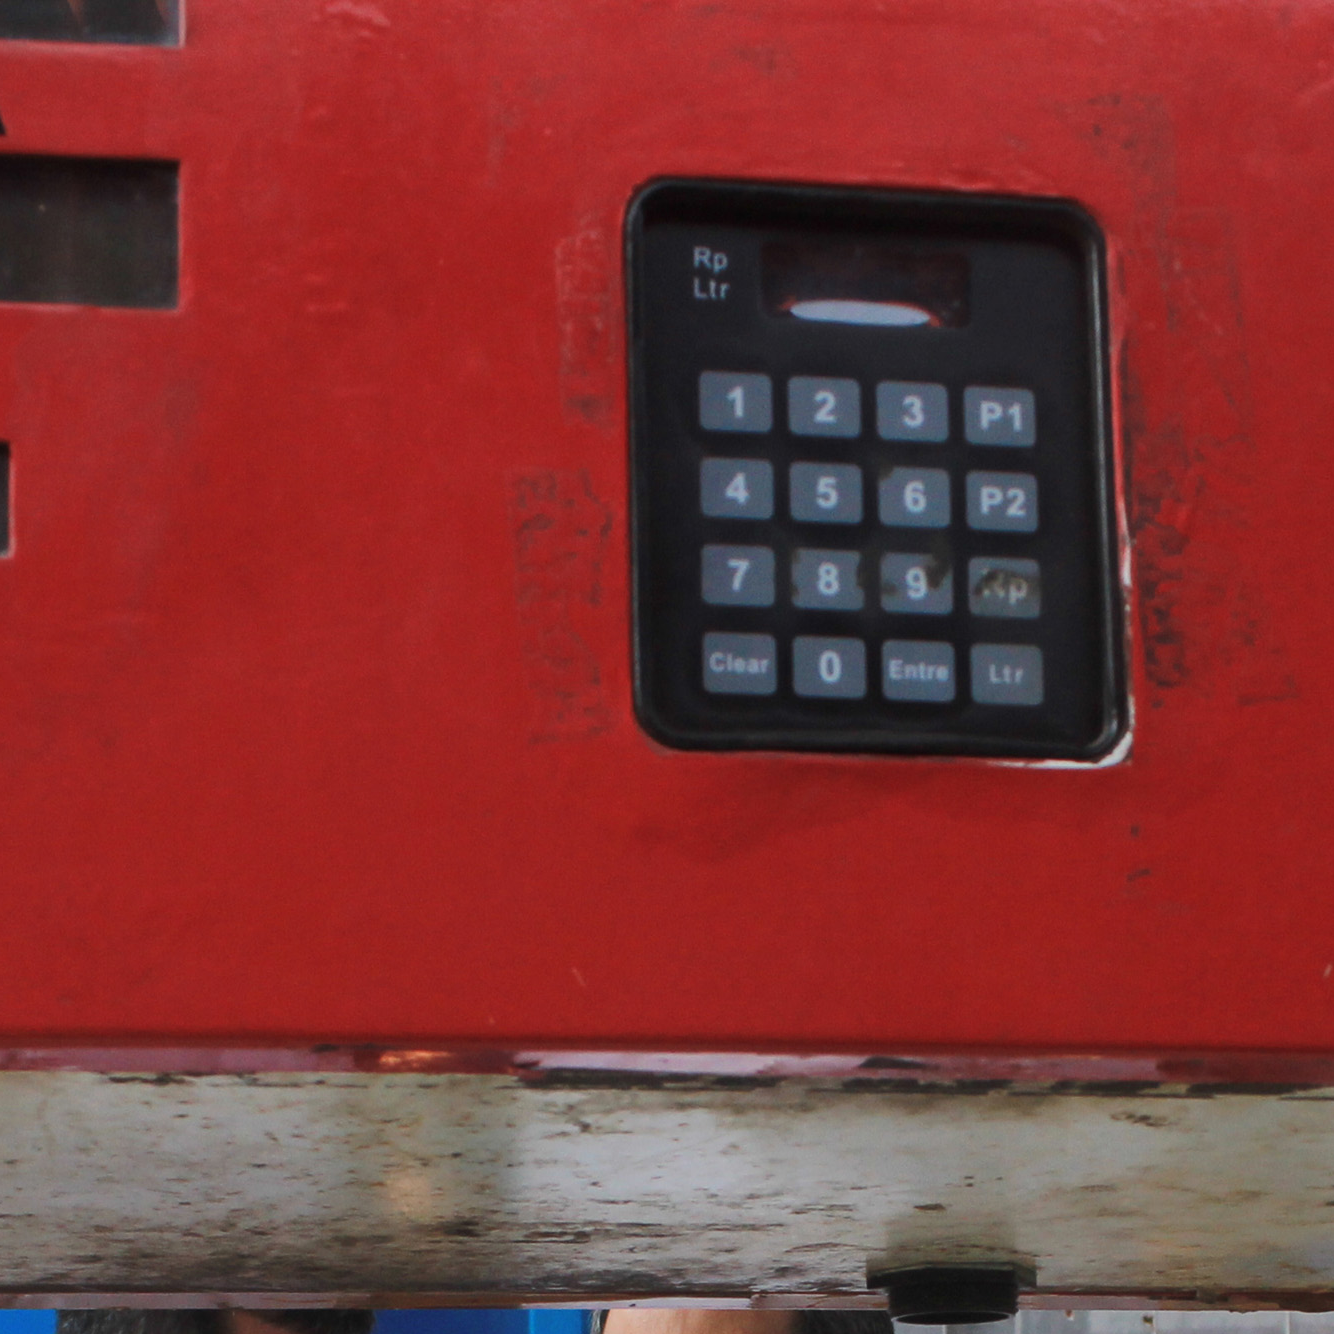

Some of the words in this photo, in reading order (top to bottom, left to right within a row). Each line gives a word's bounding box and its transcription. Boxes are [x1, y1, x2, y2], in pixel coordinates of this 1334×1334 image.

[693, 245, 728, 273] Rp
[693, 277, 730, 299] Ltr
[727, 386, 744, 418] 1
[814, 390, 837, 423] 2
[902, 395, 925, 427] 3
[979, 400, 1023, 432] P1
[725, 472, 750, 505] 4
[817, 476, 839, 509] 5
[904, 480, 927, 513] 6
[979, 485, 1026, 517] P2
[727, 558, 750, 592] 7
[818, 562, 840, 596] 8
[905, 566, 928, 600] 9
[708, 651, 769, 674] Clear
[819, 651, 842, 684] 0
[888, 659, 950, 682] Entre
[989, 664, 1025, 684] Ltr
